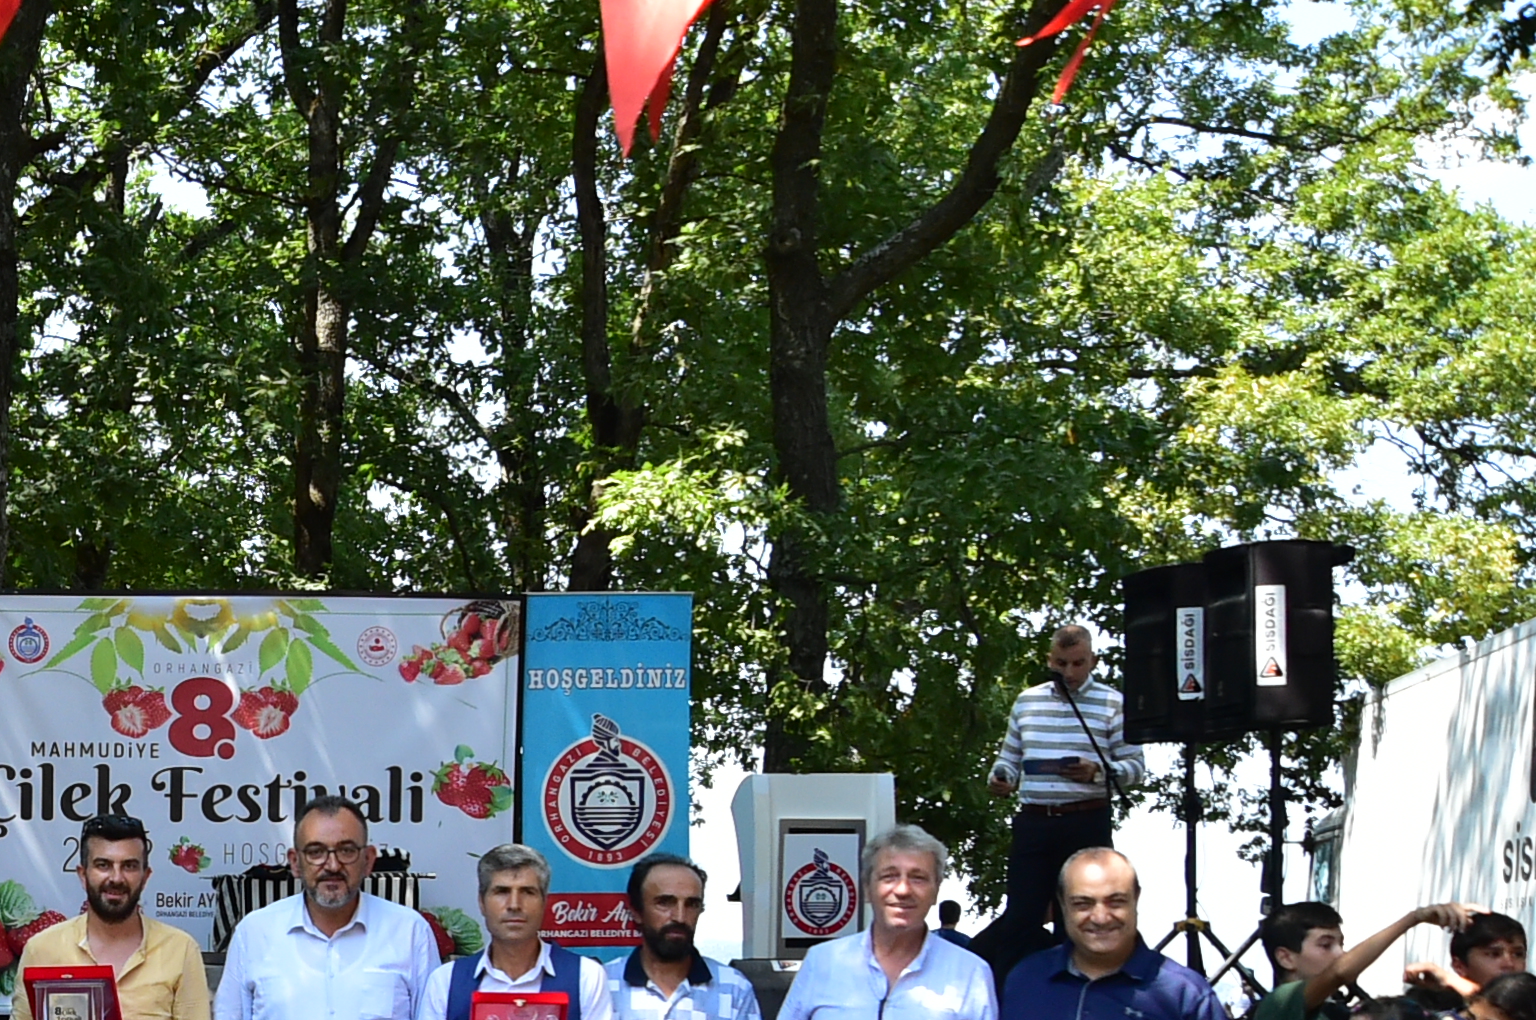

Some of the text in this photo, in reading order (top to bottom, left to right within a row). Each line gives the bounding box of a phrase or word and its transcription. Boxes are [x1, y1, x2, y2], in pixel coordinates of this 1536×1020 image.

[527, 662, 686, 696] HOŞGELDİNİZ
[168, 676, 236, 760] 8.
[151, 766, 425, 823] Festiali
[587, 850, 623, 862] 1893
[1502, 820, 1536, 884] sis
[156, 891, 194, 908] Bekir
[551, 901, 598, 925] Bekir
